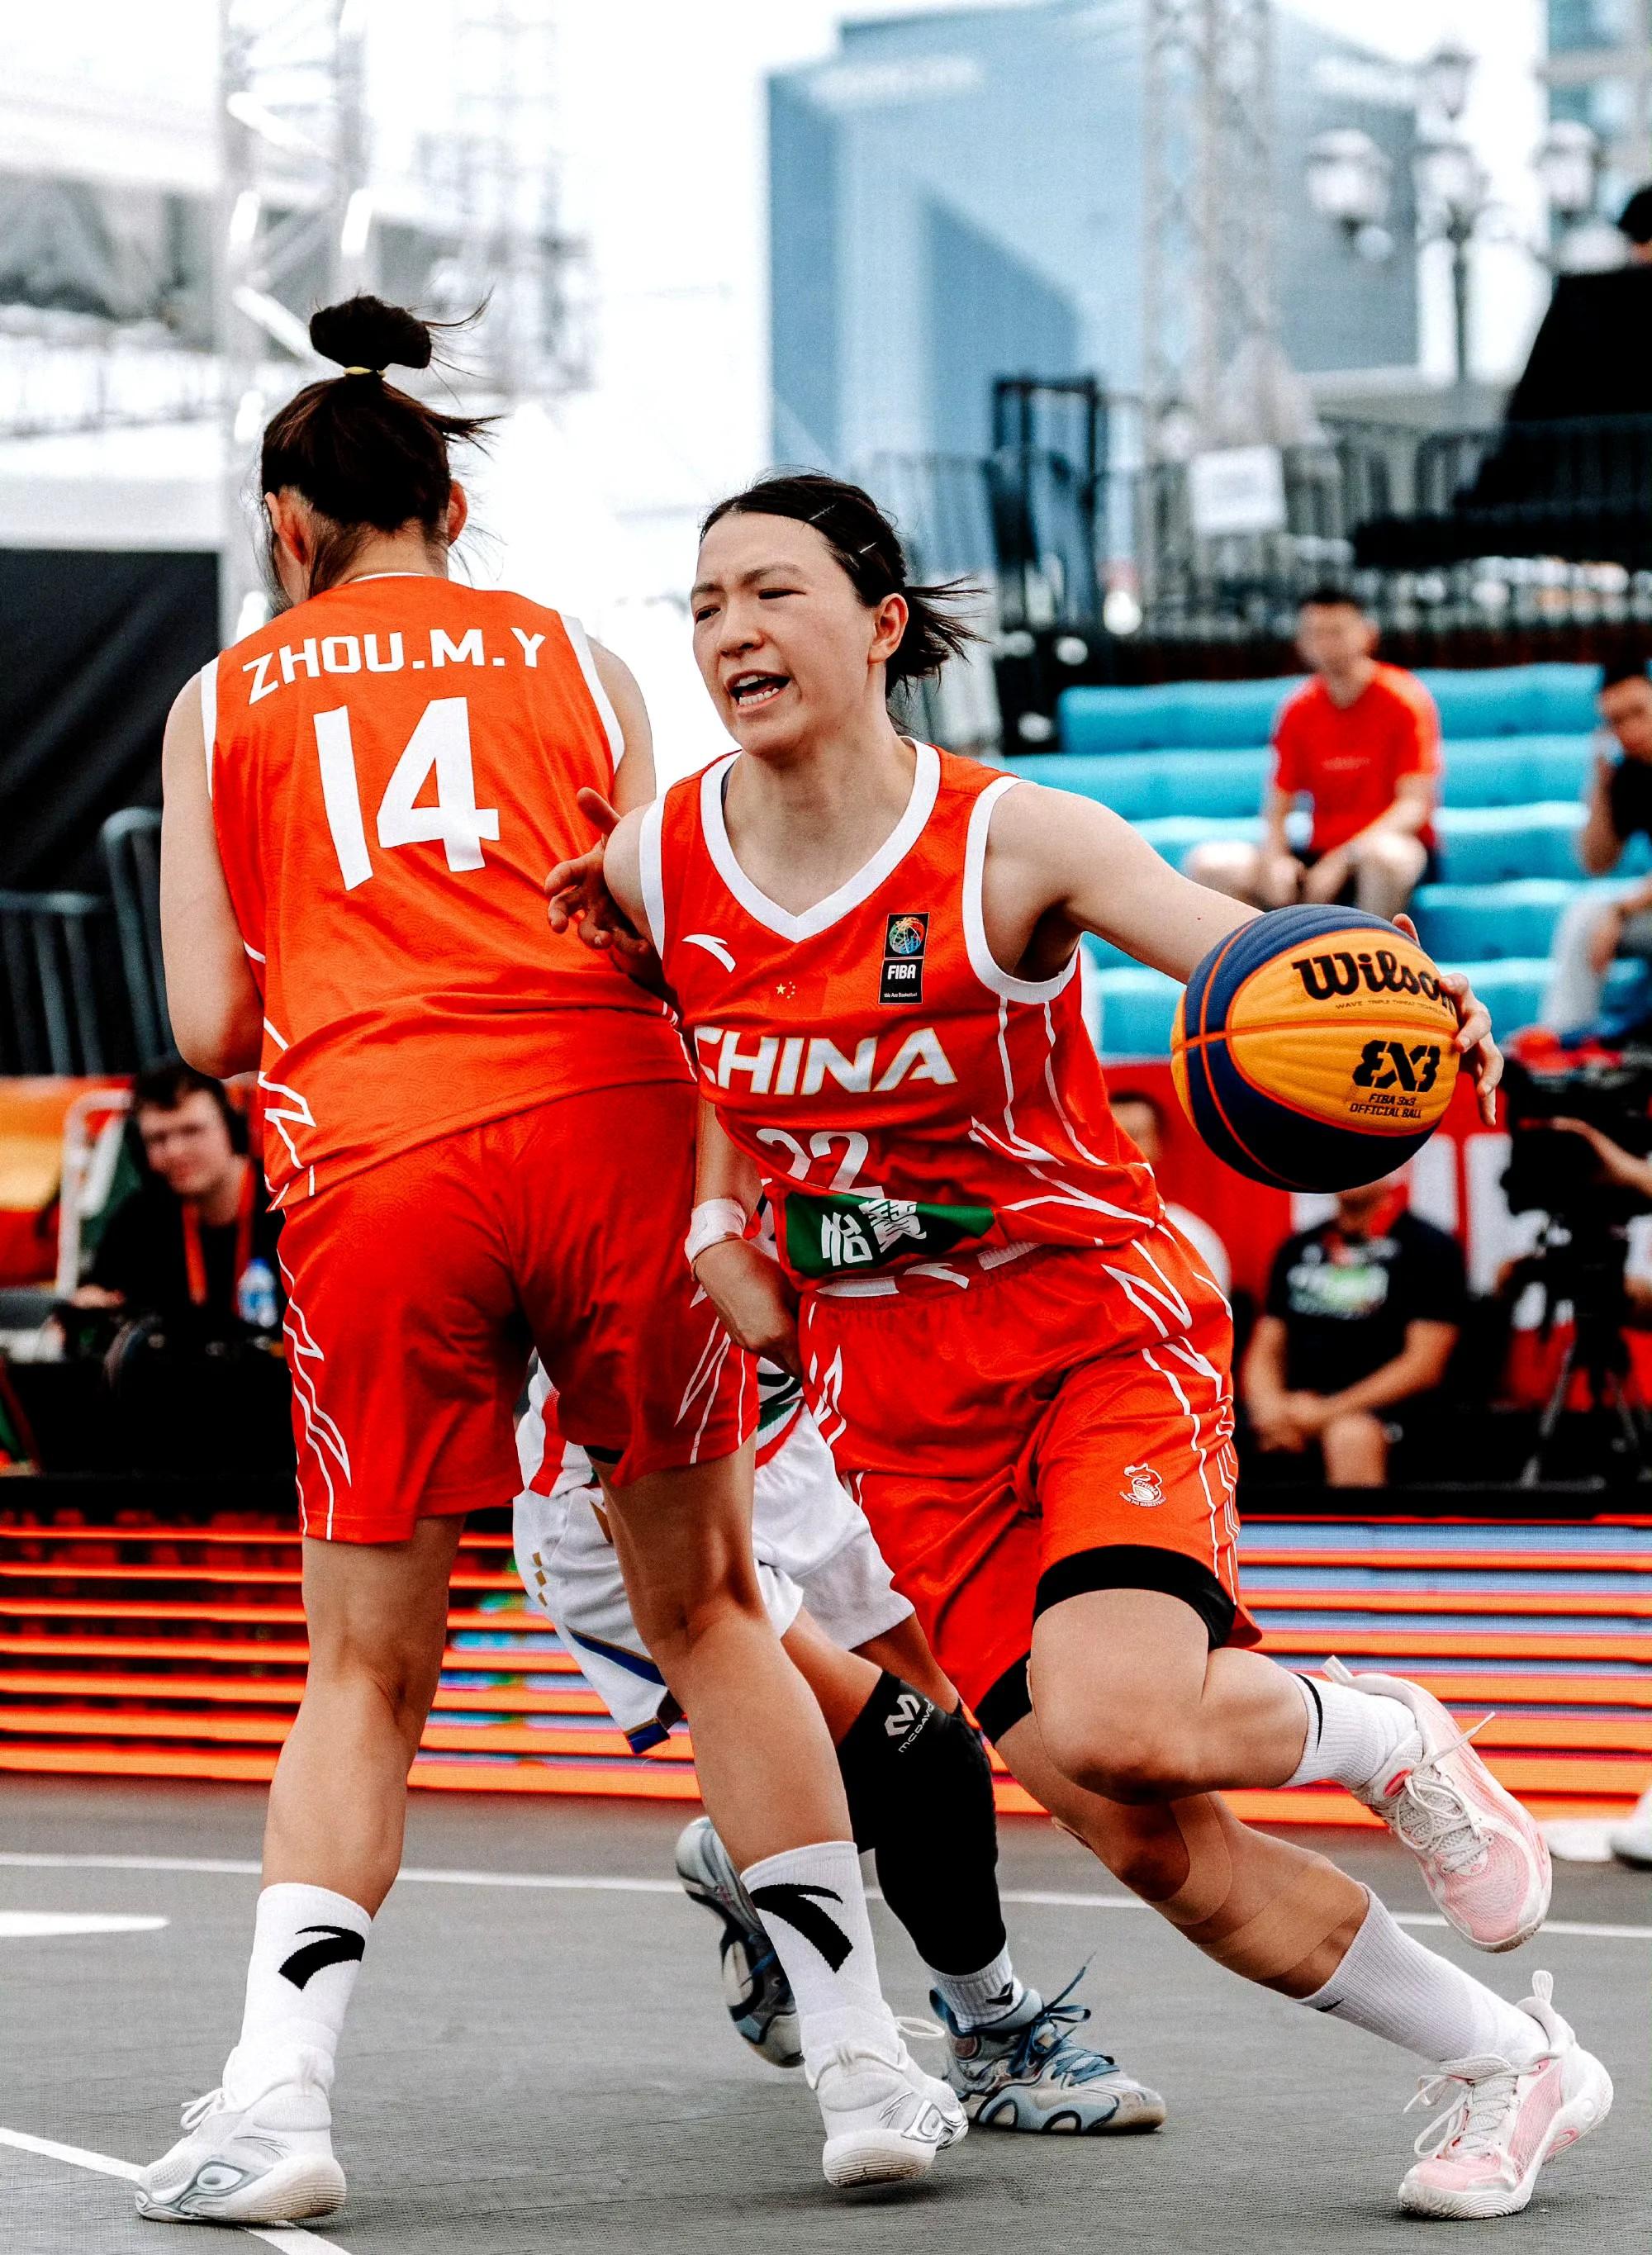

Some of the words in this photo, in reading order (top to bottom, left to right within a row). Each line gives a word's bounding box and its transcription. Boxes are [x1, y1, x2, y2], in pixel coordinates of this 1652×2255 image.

[242, 627, 546, 705] ZHOU.M.Y
[313, 696, 500, 891] 14
[887, 964, 917, 980] FIBA
[1336, 1000, 1363, 1009] WAVE
[1368, 1093, 1395, 1105] FIBA
[1349, 1103, 1398, 1117] OFFICIAL
[1401, 1107, 1422, 1119] BALL
